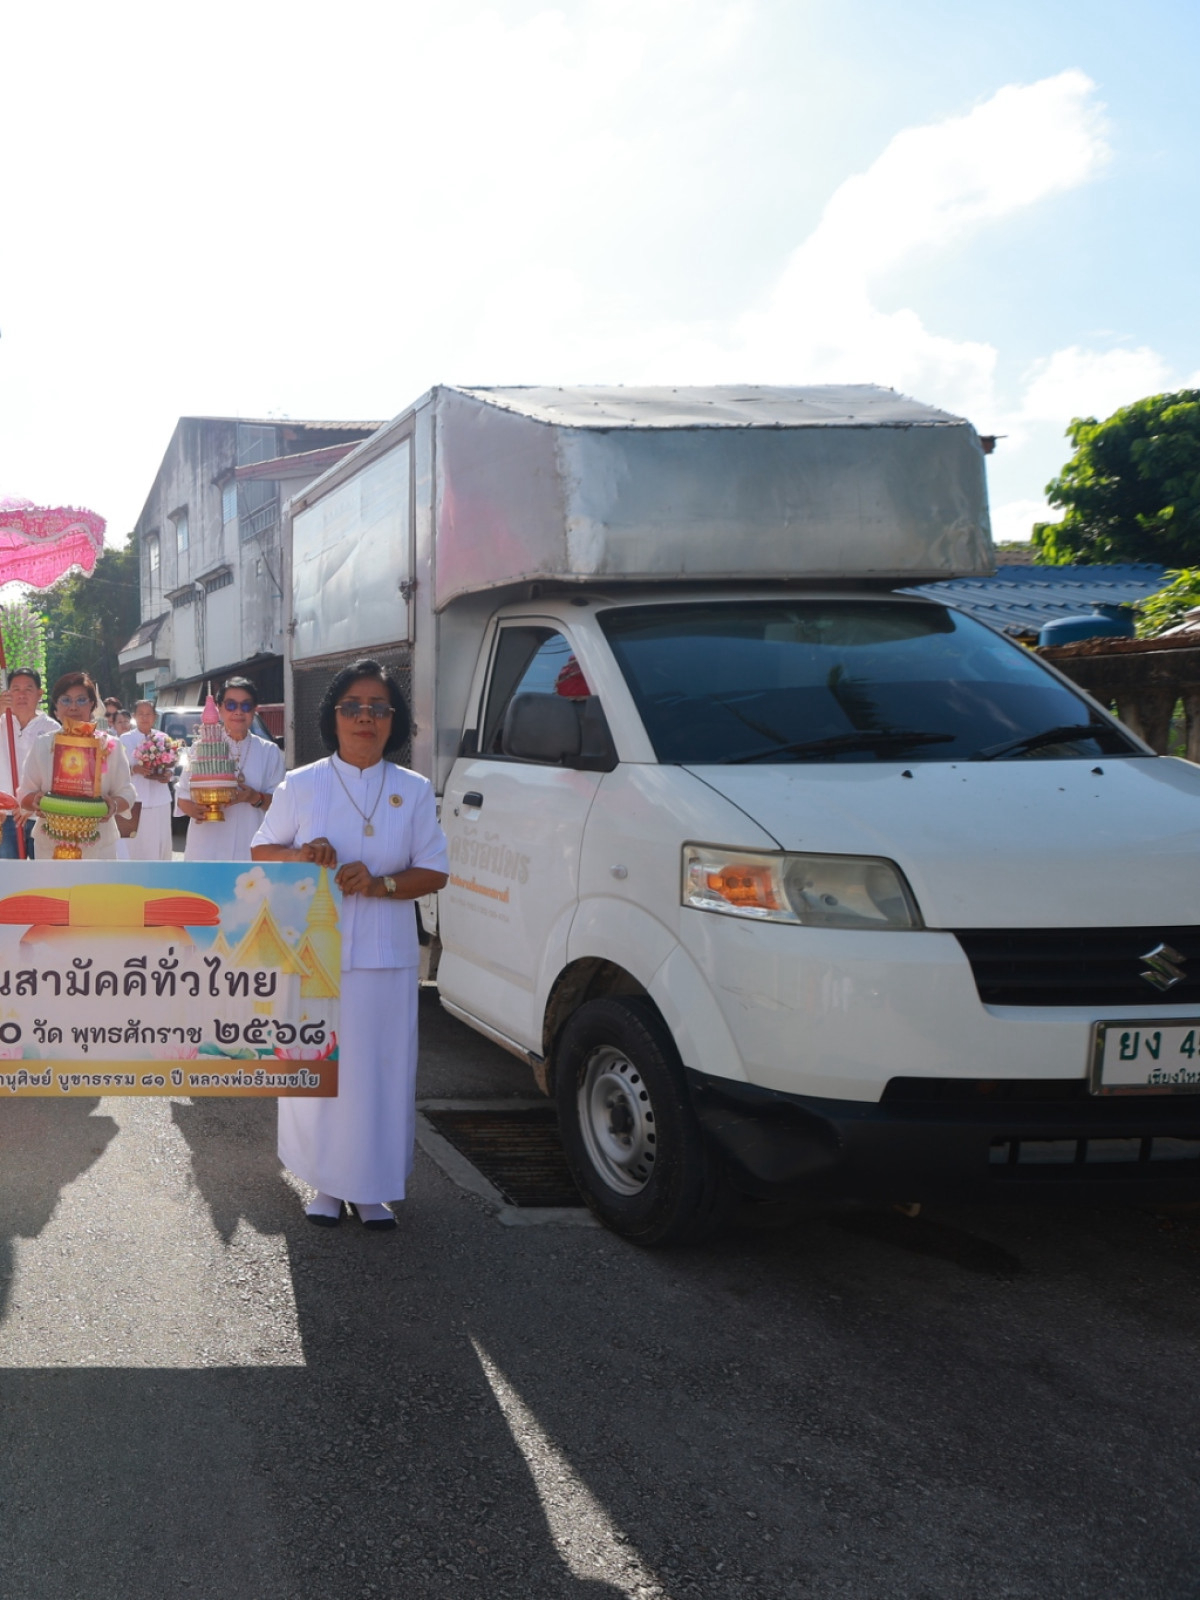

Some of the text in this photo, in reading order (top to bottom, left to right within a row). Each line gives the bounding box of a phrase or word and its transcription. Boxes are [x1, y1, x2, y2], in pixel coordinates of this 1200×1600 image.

[33, 1018, 63, 1044] วัด
[71, 1019, 202, 1053] พุทธศักราช
[214, 1018, 326, 1045] ๒๕๖๘
[1119, 1029, 1200, 1060] ยง 4
[58, 1073, 135, 1091] บูชาธรรม
[141, 1074, 165, 1087] ๘๑
[171, 1069, 183, 1086] ปี
[189, 1069, 320, 1087] หลวงพ่อธัมมชโย
